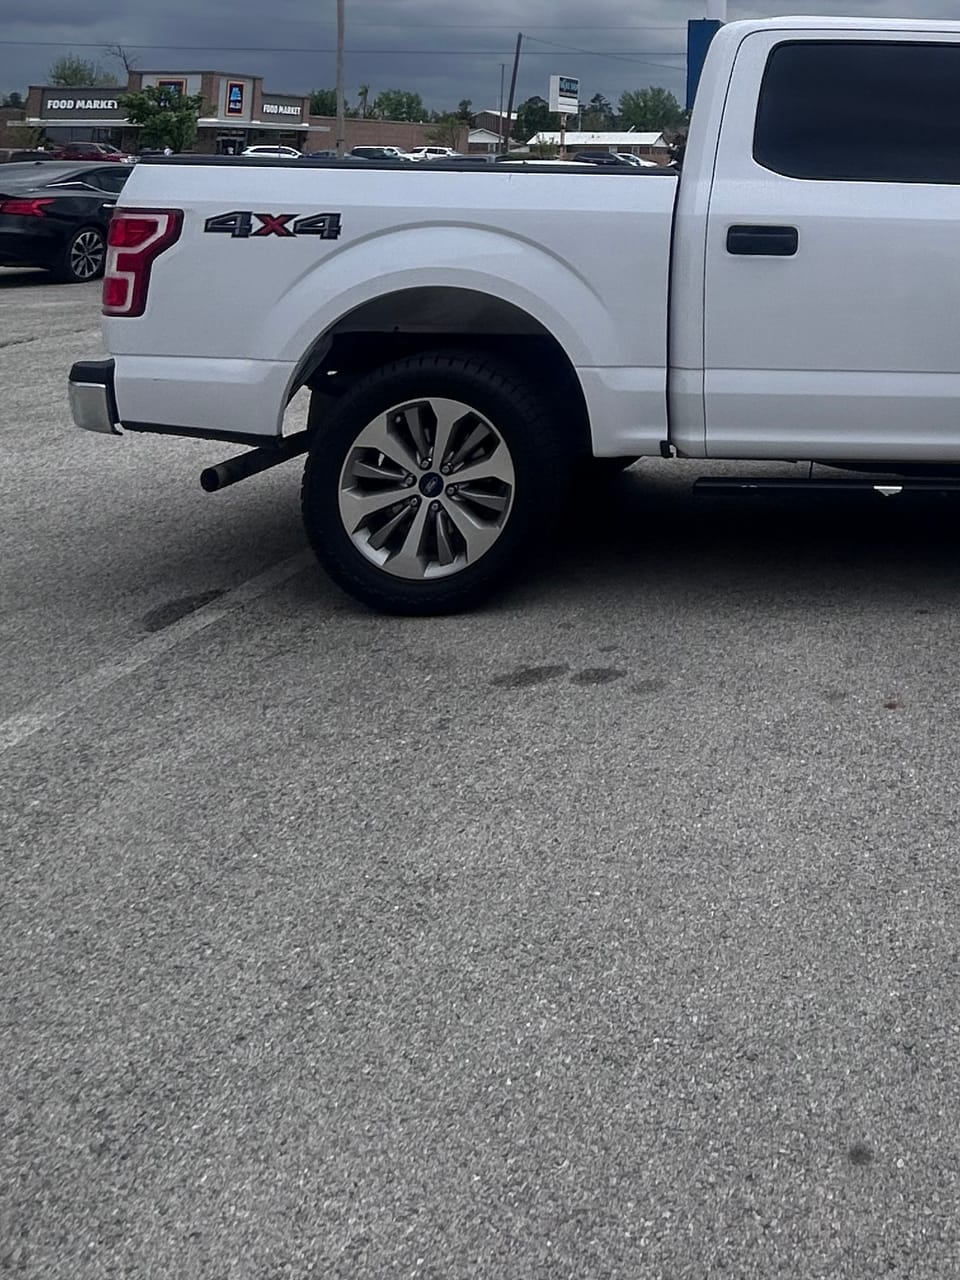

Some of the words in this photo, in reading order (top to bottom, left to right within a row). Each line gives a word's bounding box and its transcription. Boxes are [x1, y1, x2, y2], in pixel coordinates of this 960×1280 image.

[47, 99, 73, 109] FOOD
[263, 104, 278, 114] FOOD
[278, 105, 302, 115] MARKET
